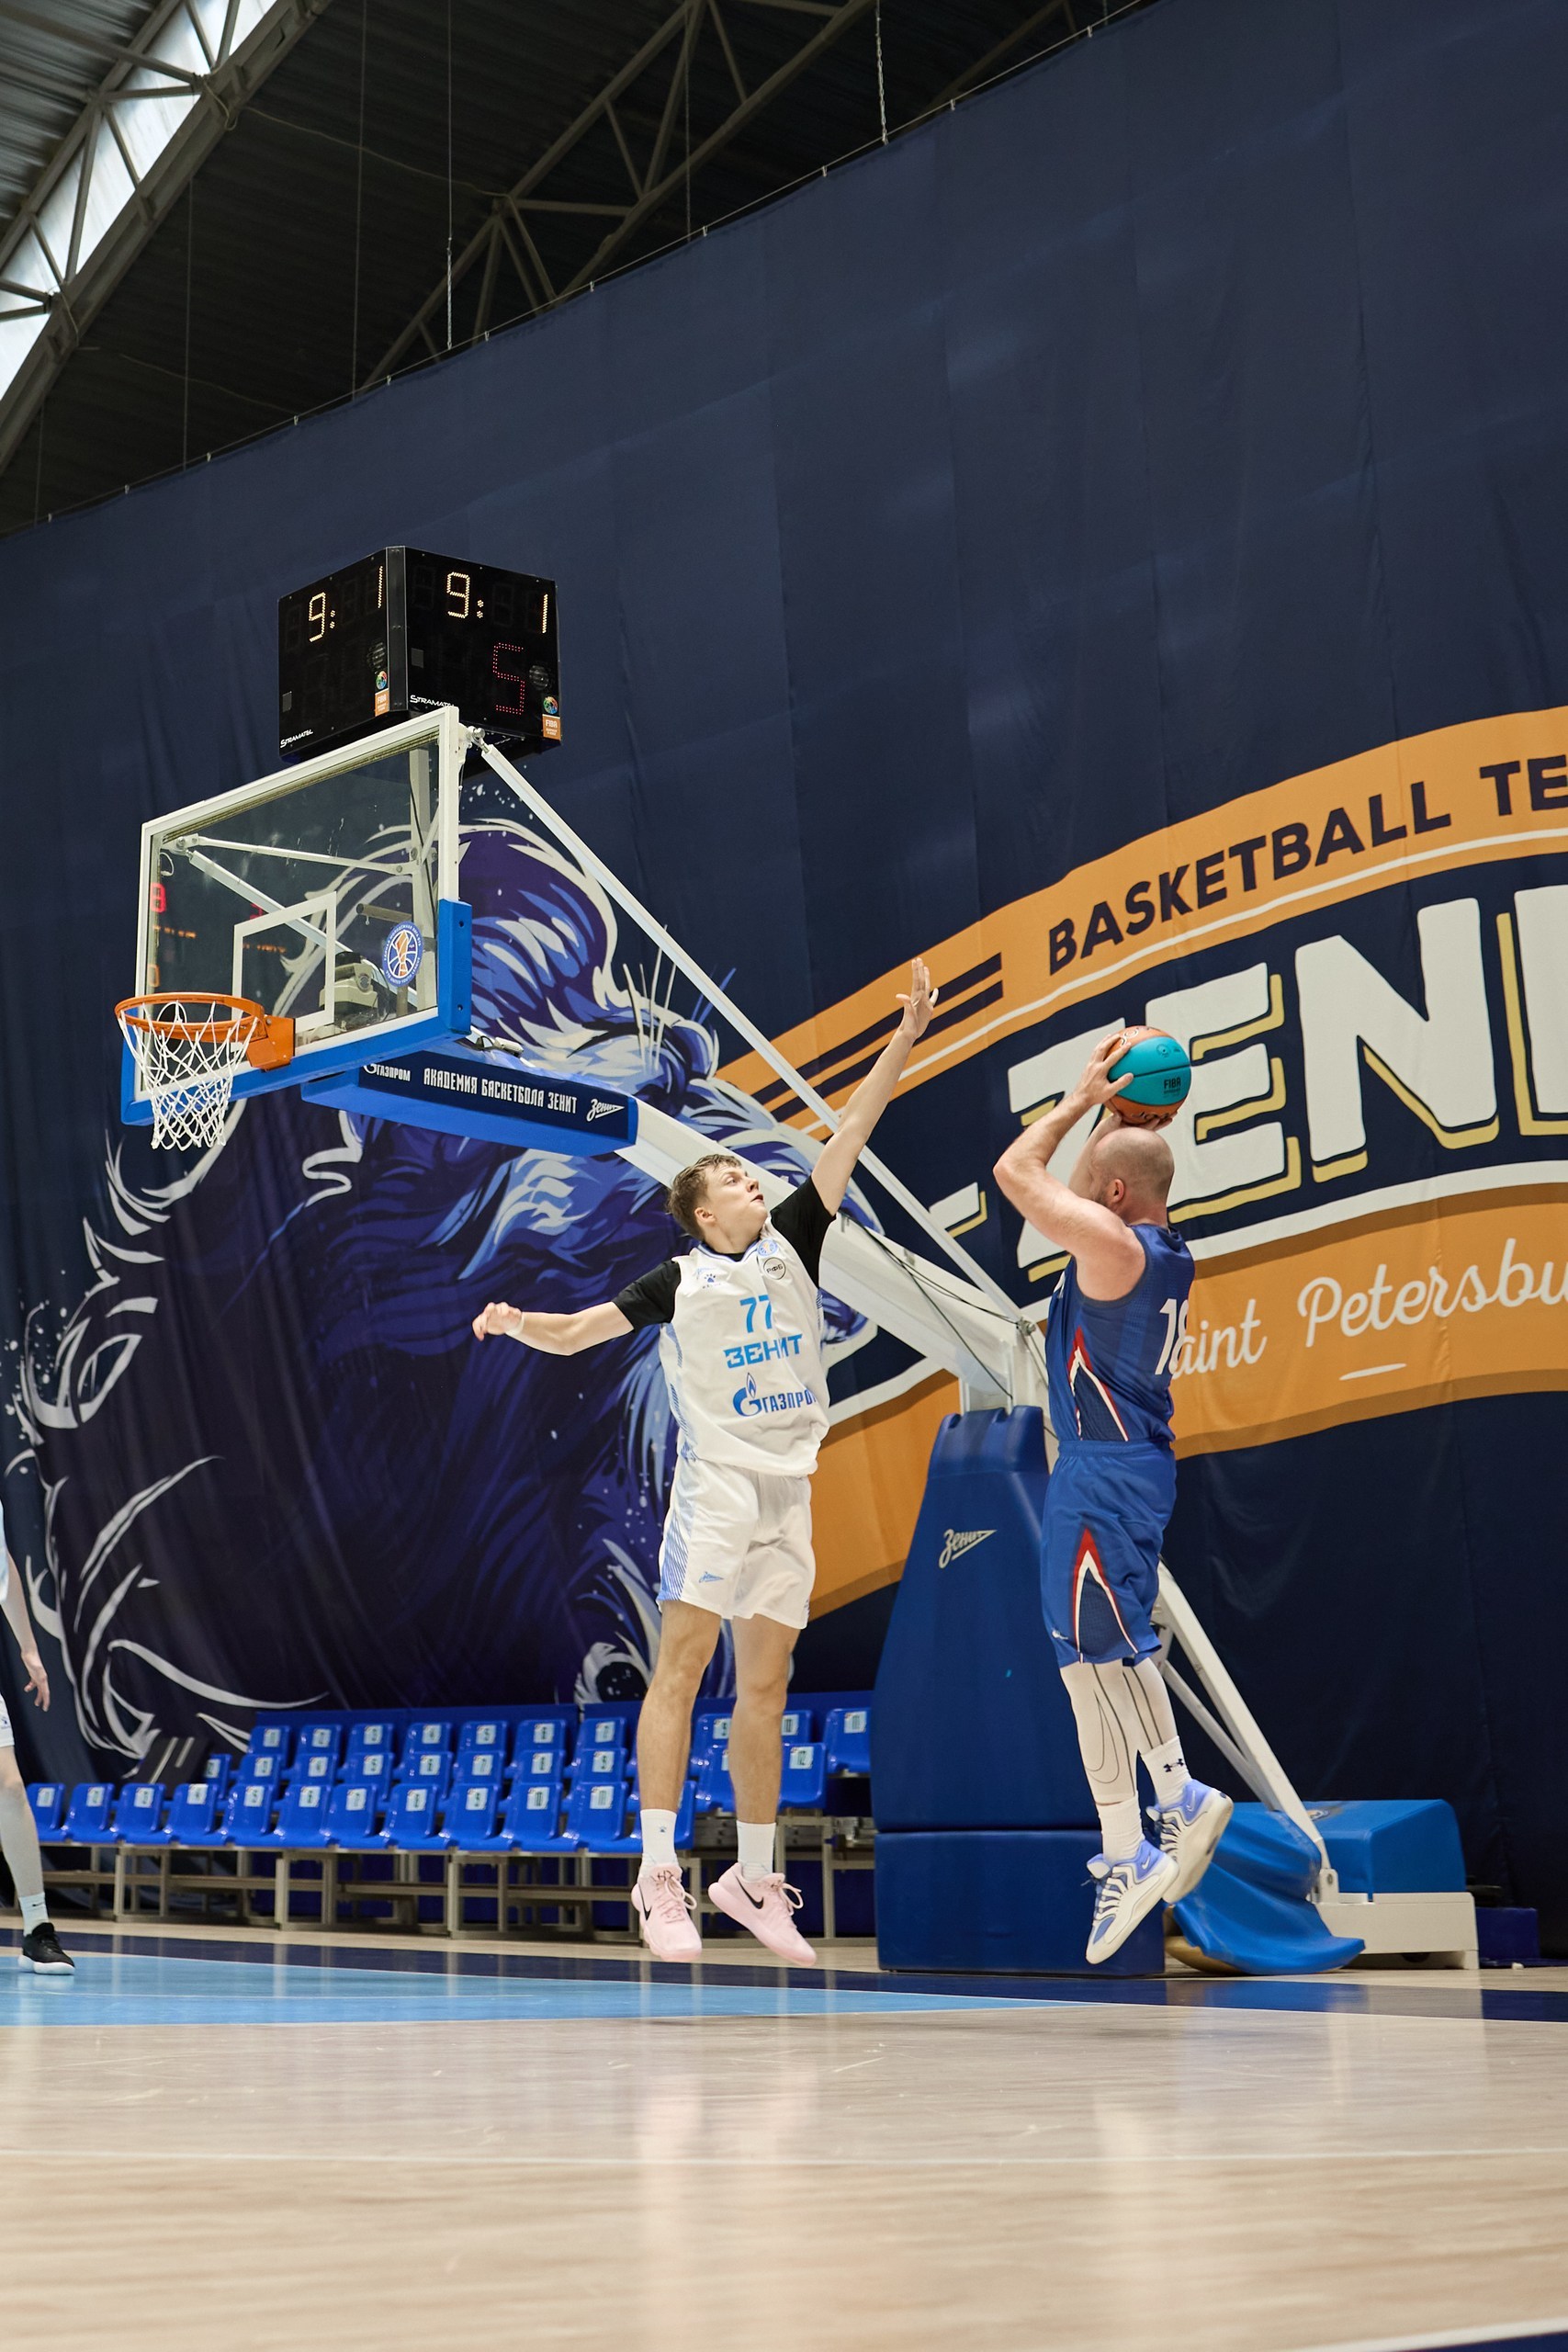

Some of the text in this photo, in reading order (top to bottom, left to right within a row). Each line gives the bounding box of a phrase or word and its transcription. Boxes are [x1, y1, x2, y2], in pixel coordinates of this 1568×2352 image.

[1049, 781, 1451, 976] BASKETBALL
[423, 1068, 578, 1114] АКАДЕМИЯ БАСКЕТБОЛА ЗЕНИТ
[1163, 1077, 1181, 1090] FIBA
[739, 1294, 773, 1334] 77
[723, 1333, 803, 1369] ЗЕНИТ
[1171, 1297, 1268, 1380] aint
[761, 1387, 817, 1414] ГАЗПРО
